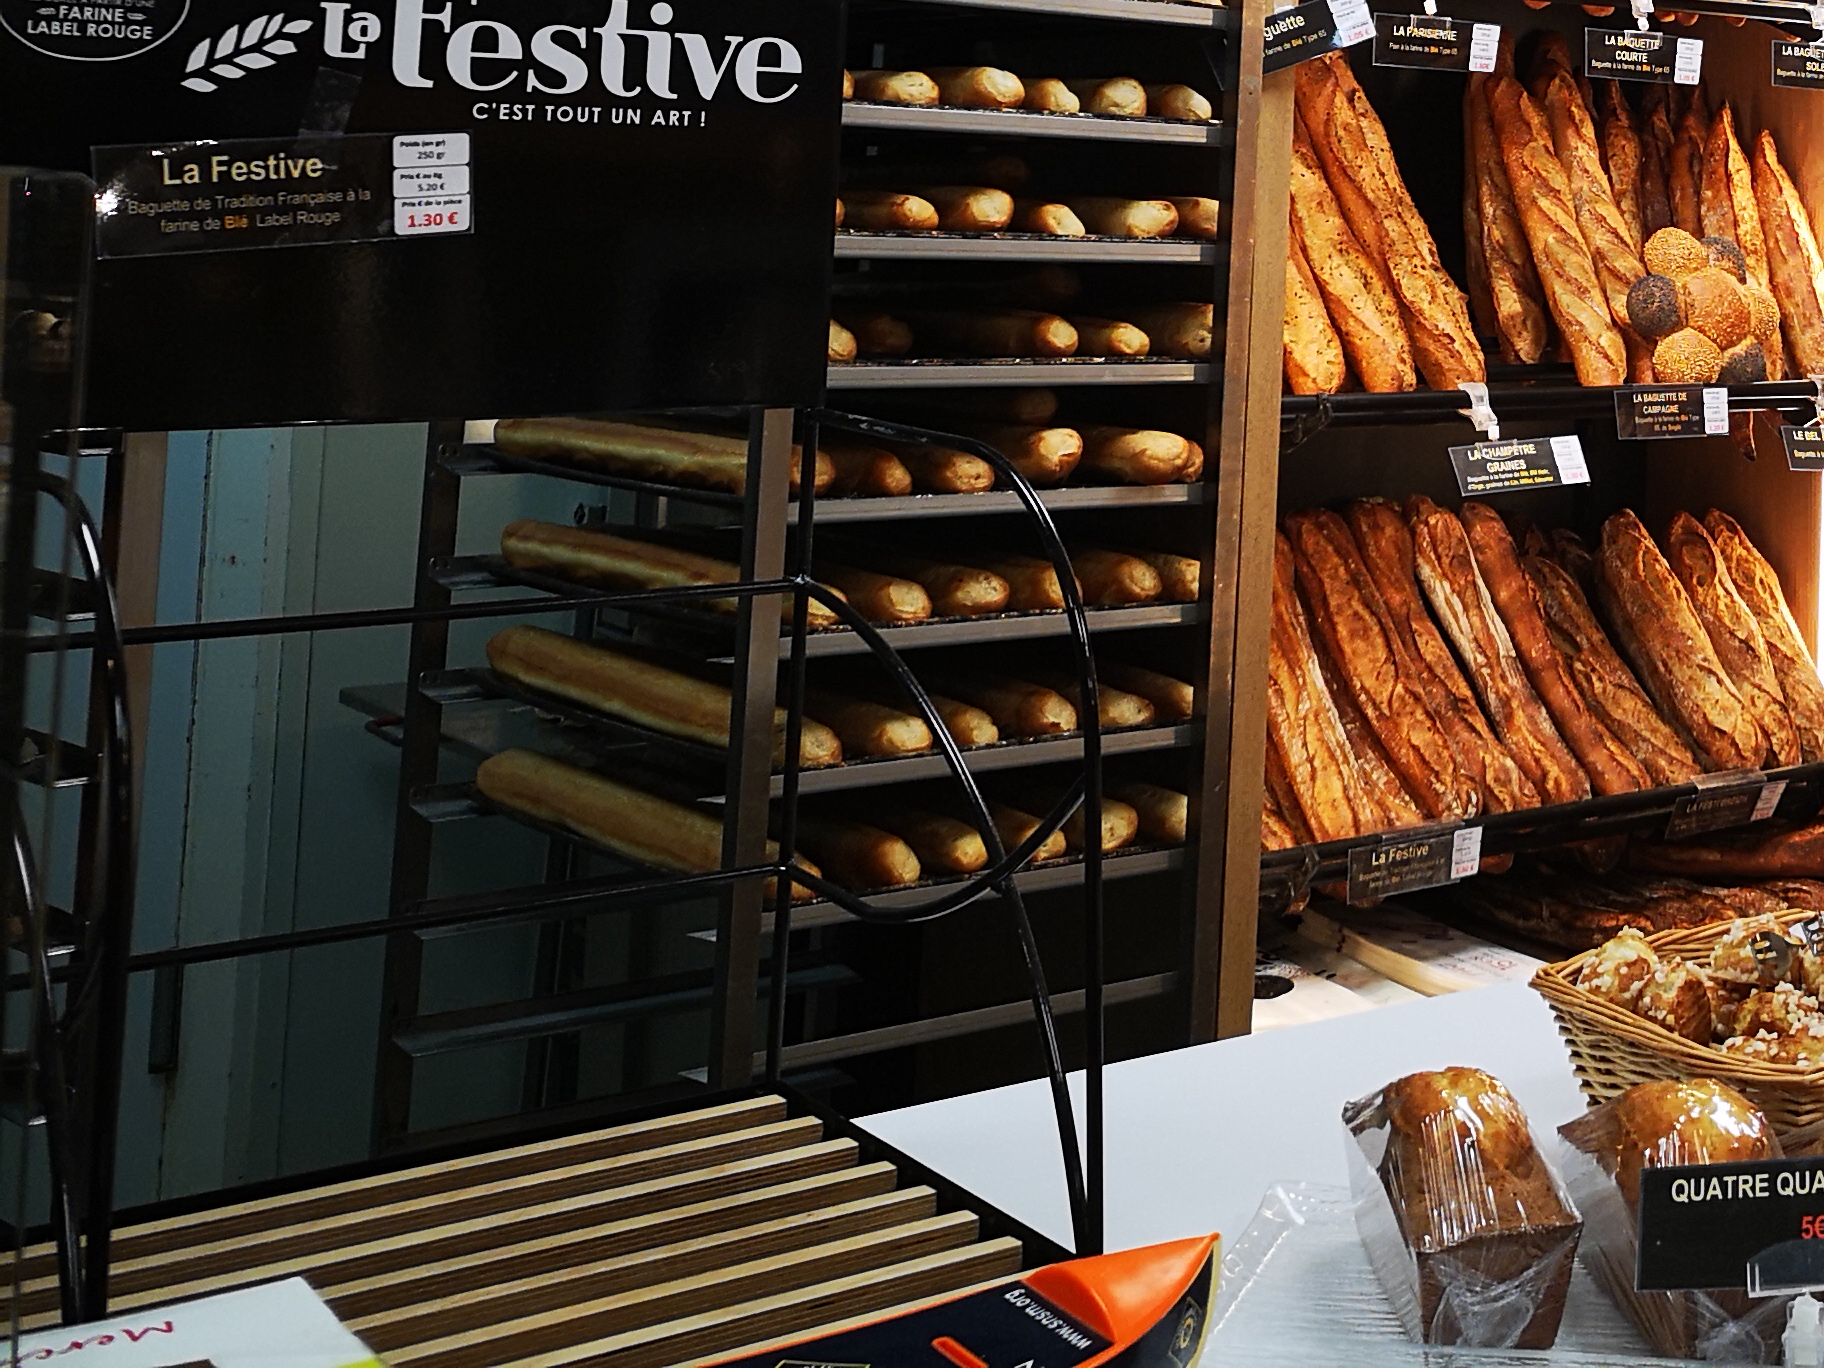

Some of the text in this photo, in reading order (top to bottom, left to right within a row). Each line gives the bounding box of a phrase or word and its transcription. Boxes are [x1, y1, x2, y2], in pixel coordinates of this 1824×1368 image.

[59, 5, 124, 22] FARINE
[27, 20, 153, 39] LABEL ROUGE
[321, 1, 380, 58] La
[1393, 25, 1404, 36] LA
[1605, 35, 1660, 49] LA BAGUETTE
[1616, 51, 1648, 62] COURTE
[1782, 46, 1792, 55] LA
[1806, 61, 1824, 72] SOLE
[473, 101, 706, 127] C'EST TOUT UN ART !
[162, 152, 323, 185] La Festive
[127, 187, 371, 216] Baguette de Tradition Française à la
[160, 209, 340, 232] farine de Blé Label Rouge
[408, 212, 458, 227] 1.30 €
[1633, 394, 1642, 403] LA
[1793, 431, 1803, 440] LE
[1468, 450, 1481, 461] LA
[1487, 459, 1526, 472] GRAINES
[1372, 845, 1429, 866] La Festive
[1671, 1171, 1770, 1205] QUATRE
[1003, 1288, 1093, 1350] www.snsm.org
